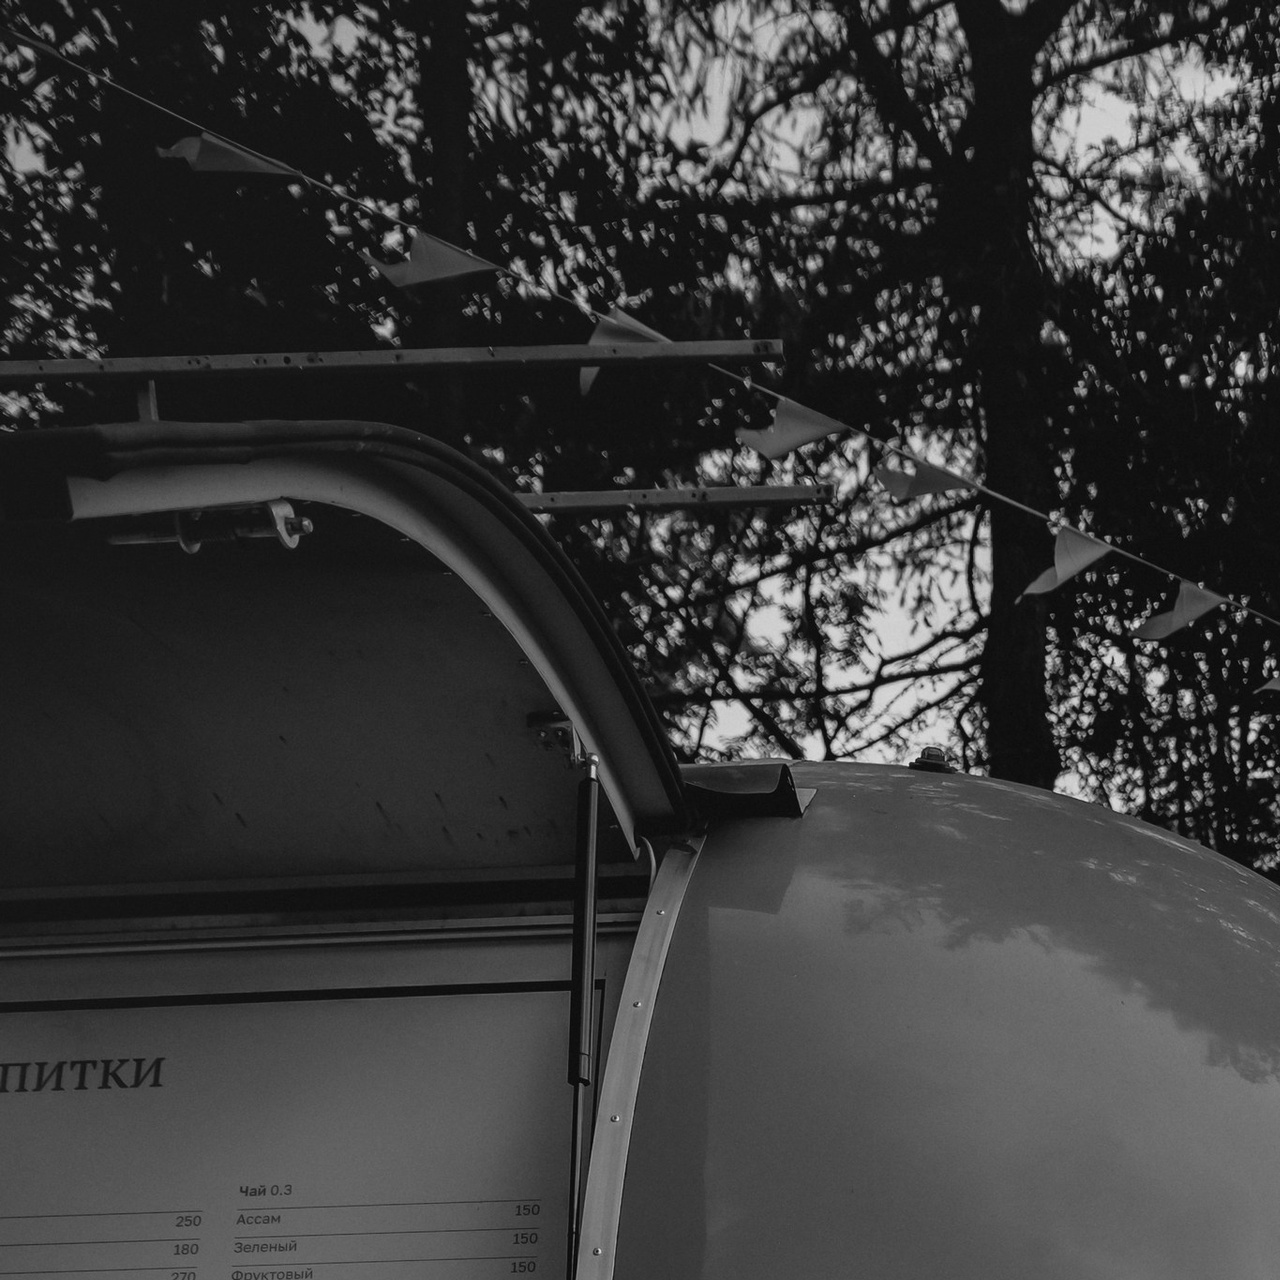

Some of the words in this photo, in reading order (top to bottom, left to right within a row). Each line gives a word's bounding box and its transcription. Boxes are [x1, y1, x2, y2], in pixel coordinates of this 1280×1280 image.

[0, 1057, 165, 1093] ПИТКИ
[239, 1185, 266, 1197] Чай
[270, 1184, 292, 1196] 0.3
[515, 1204, 540, 1216] 150
[175, 1216, 202, 1227] 250
[236, 1214, 281, 1225] Ассам
[512, 1233, 538, 1244] 150
[173, 1243, 199, 1256] 180
[234, 1240, 297, 1253] Зеленый
[510, 1261, 536, 1273] 150
